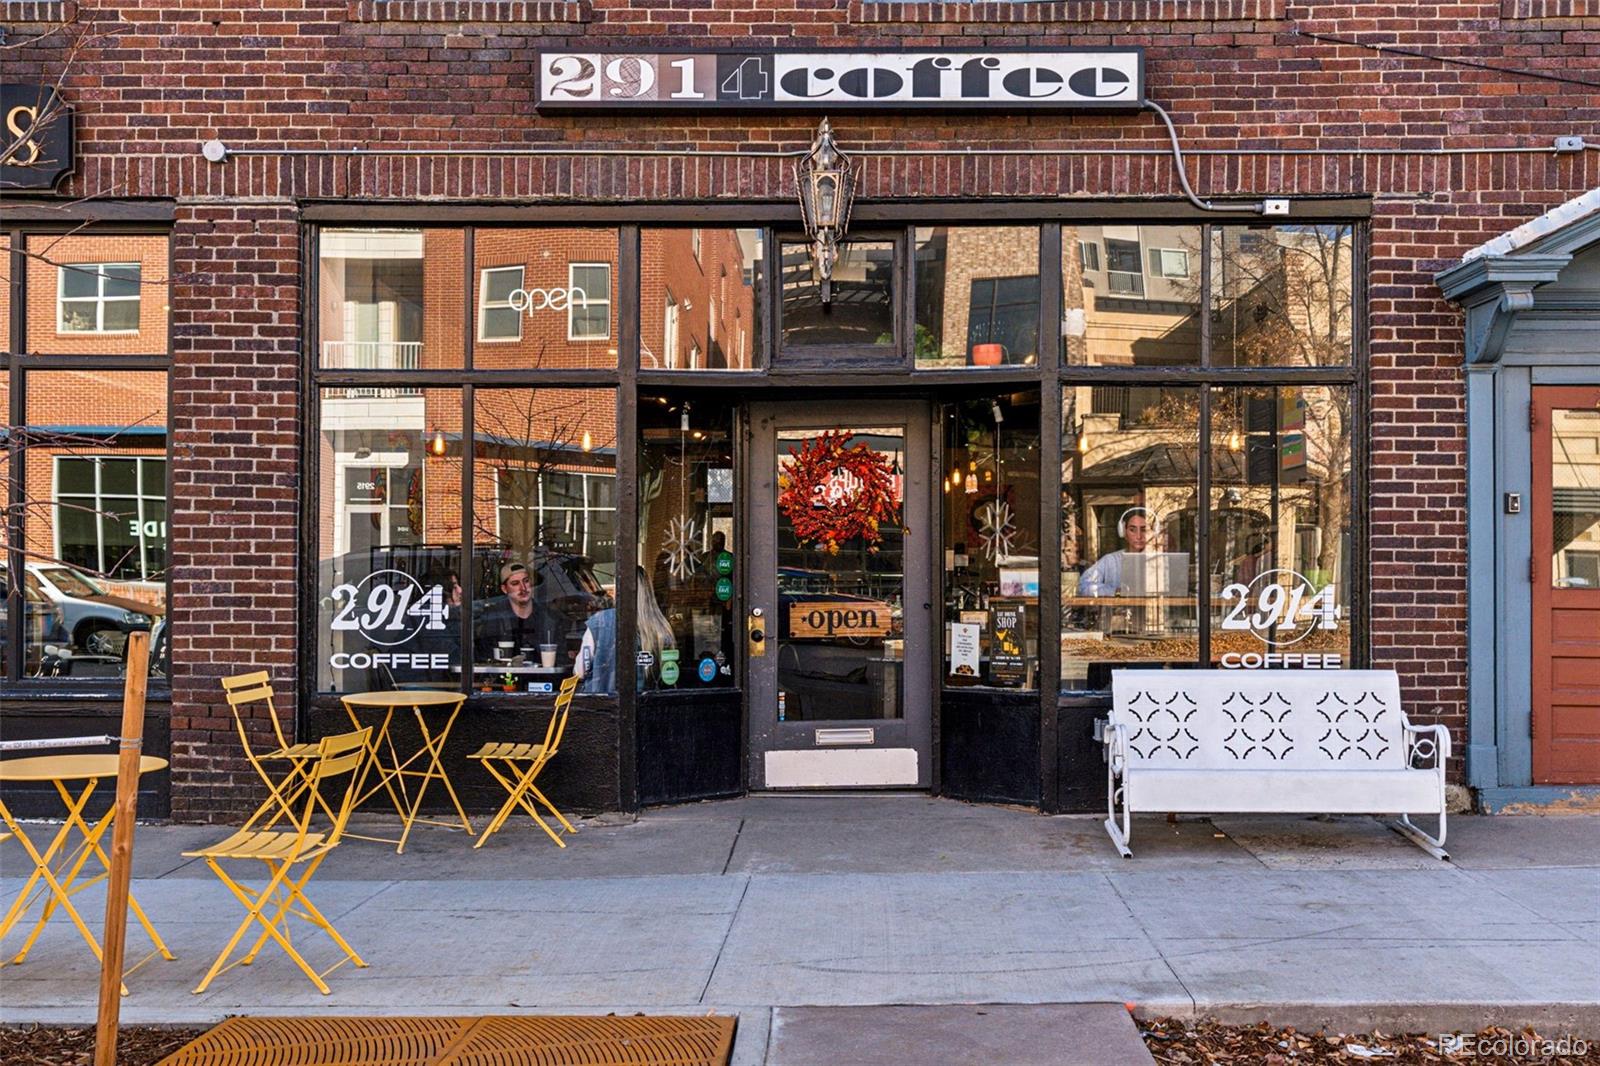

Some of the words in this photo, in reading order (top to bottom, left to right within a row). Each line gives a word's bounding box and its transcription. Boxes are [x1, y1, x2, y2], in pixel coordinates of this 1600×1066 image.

[549, 55, 768, 100] 2914
[780, 56, 1130, 98] coffee
[508, 286, 587, 318] open
[330, 583, 449, 631] 2914
[1220, 583, 1341, 630] 2914
[808, 608, 880, 637] open
[996, 617, 1018, 629] SHOP
[329, 652, 450, 670] COFFEE
[1220, 652, 1341, 669] COFFEE
